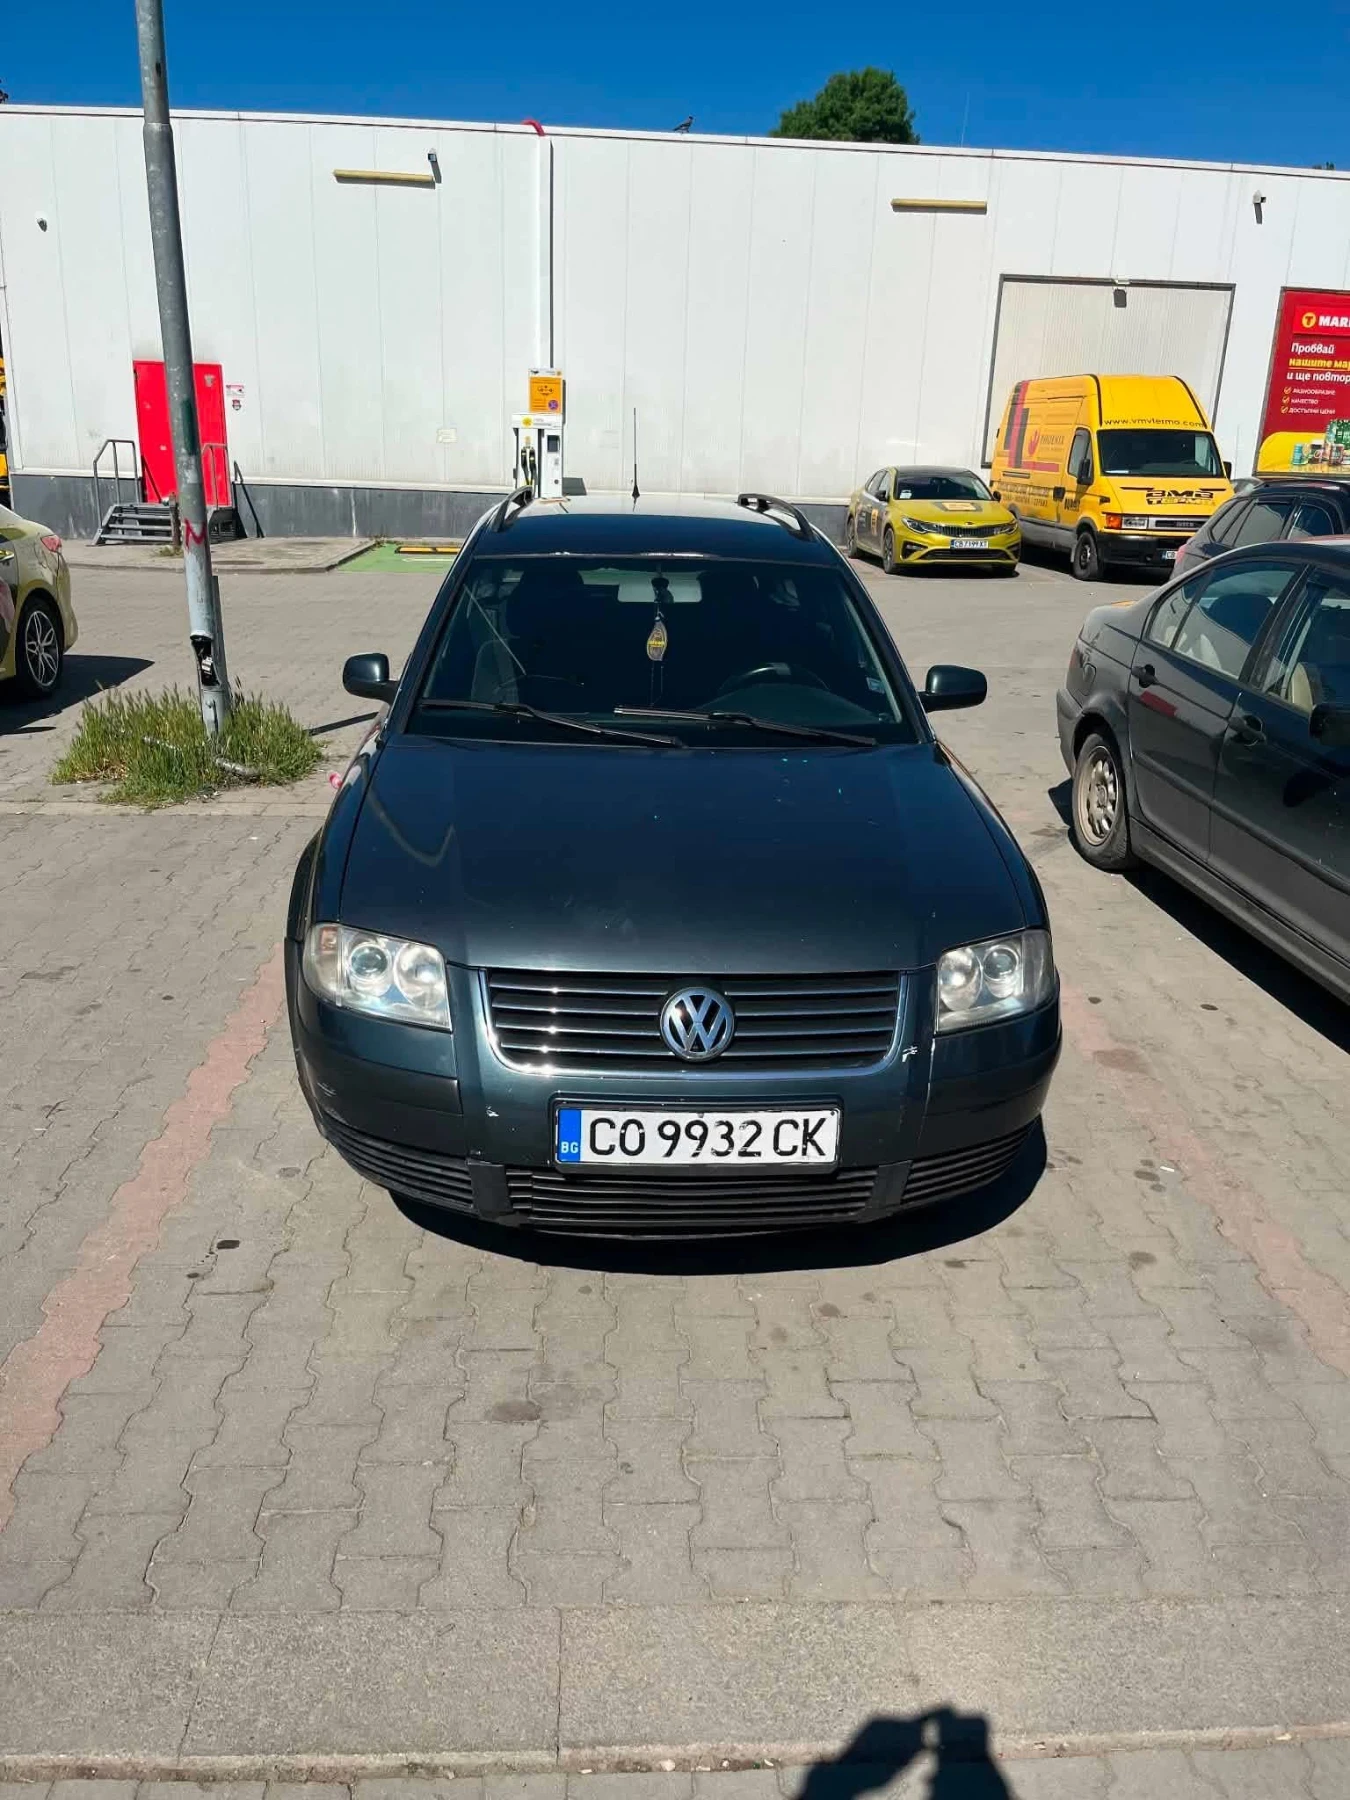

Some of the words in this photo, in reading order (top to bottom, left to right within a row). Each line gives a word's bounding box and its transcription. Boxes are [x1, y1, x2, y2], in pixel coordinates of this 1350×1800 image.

[1318, 315, 1350, 328] MAR
[1291, 342, 1335, 355] Пробвай
[1289, 358, 1332, 368] нашите
[1287, 372, 1294, 380] и
[1295, 372, 1311, 382] ще
[560, 1141, 579, 1154] BG
[589, 1117, 646, 1157] CO
[657, 1119, 762, 1158] 9932
[772, 1117, 827, 1158] CK
